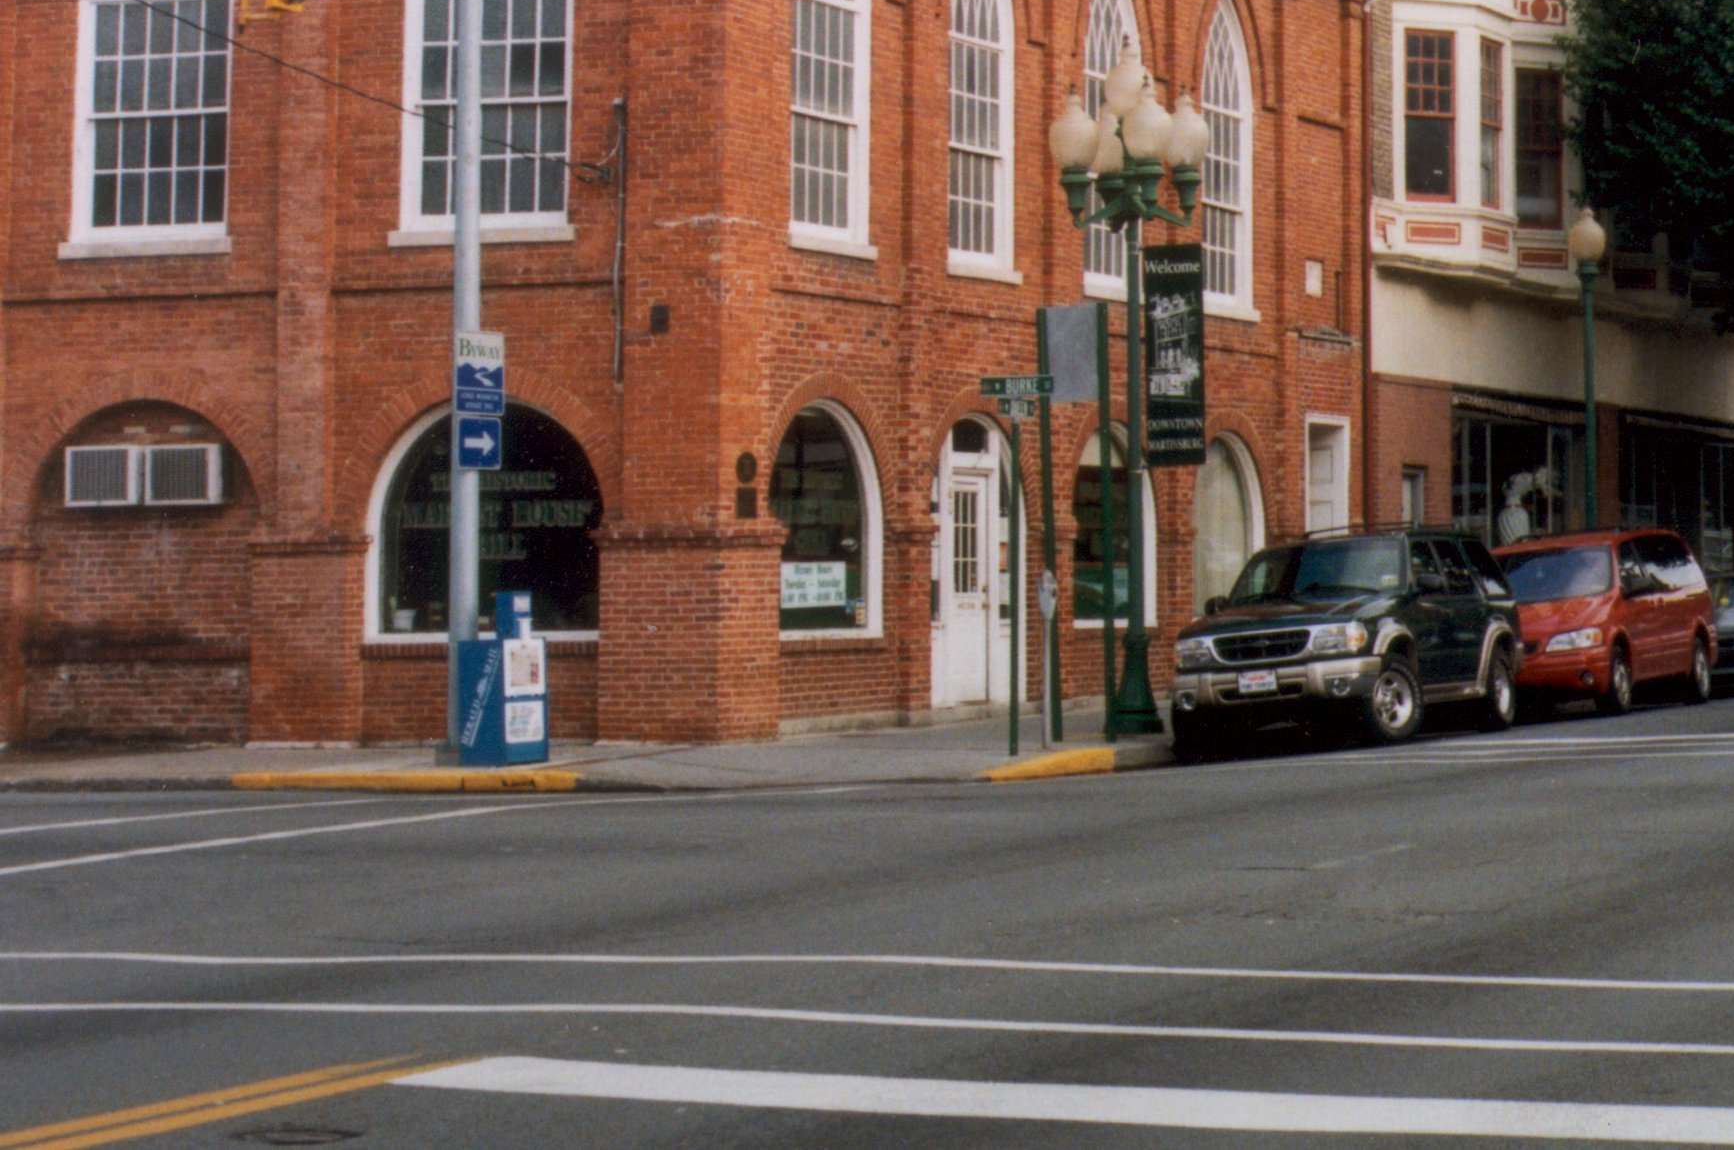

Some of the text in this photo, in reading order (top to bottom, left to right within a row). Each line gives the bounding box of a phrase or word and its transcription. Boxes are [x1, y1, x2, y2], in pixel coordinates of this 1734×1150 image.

[1144, 258, 1201, 274] Welcome
[1005, 377, 1039, 394] BURKE
[1147, 417, 1204, 431] DOWNTOWN
[478, 470, 557, 491] ISTORIC
